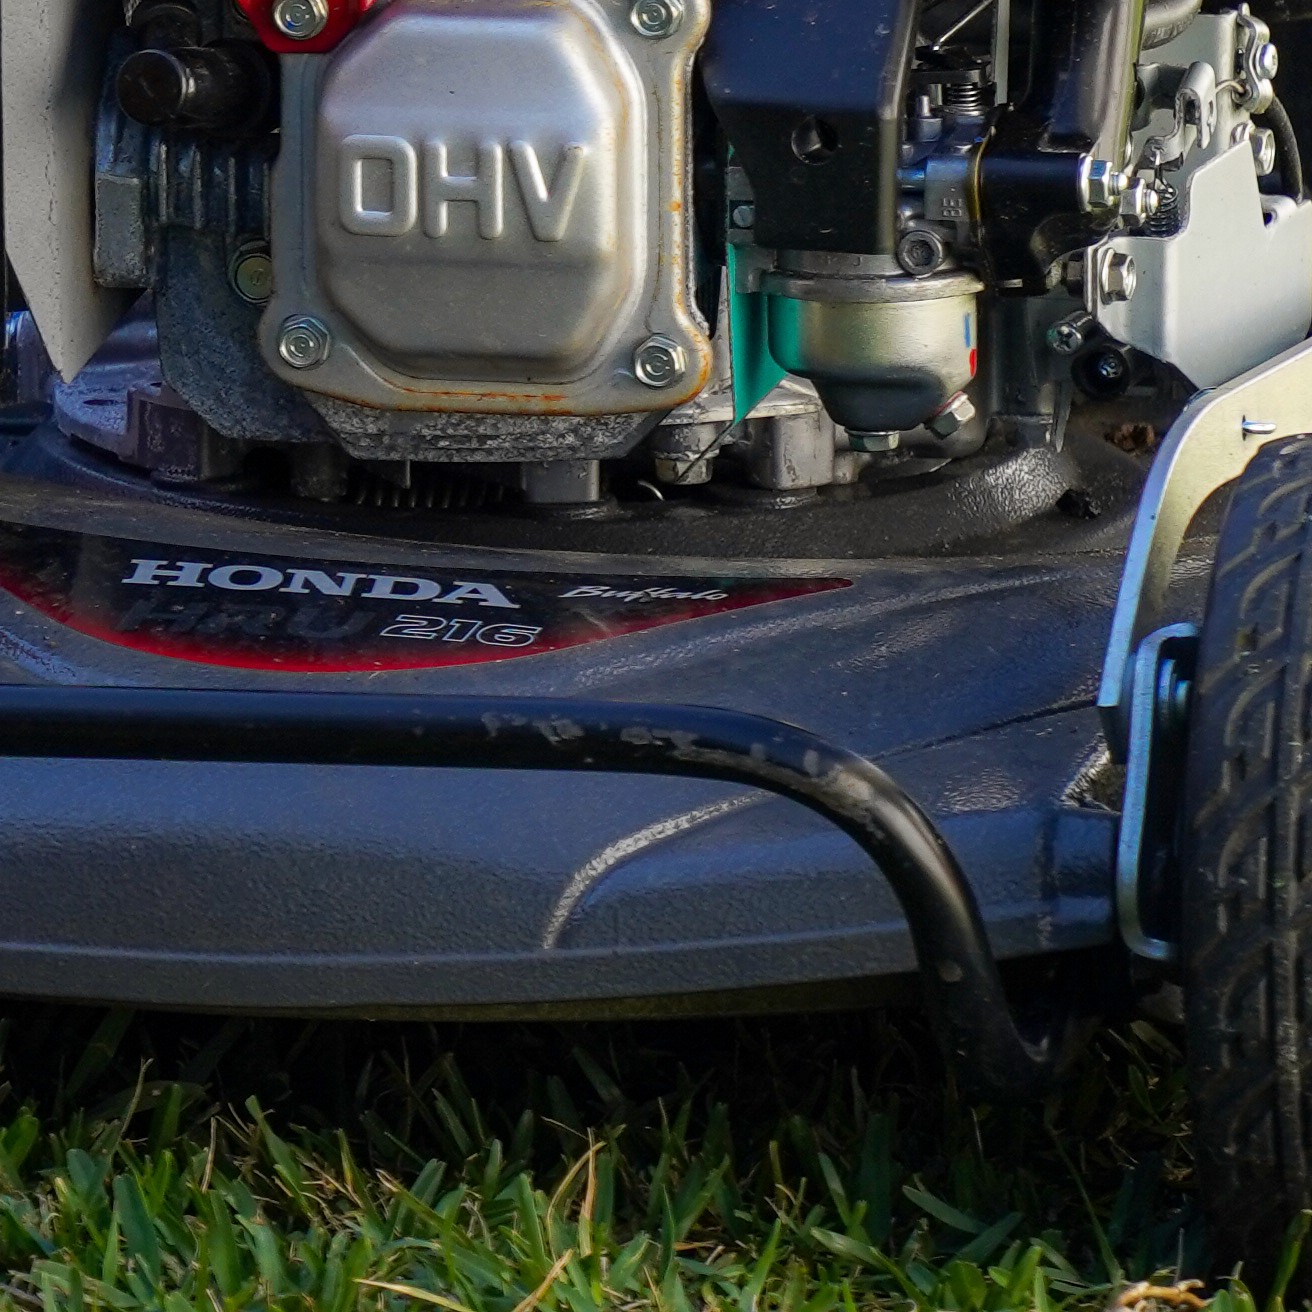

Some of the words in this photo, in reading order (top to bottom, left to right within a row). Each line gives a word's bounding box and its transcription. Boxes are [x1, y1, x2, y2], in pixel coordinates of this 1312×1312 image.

[339, 134, 587, 243] OHV
[121, 559, 522, 610] HONDA
[379, 614, 544, 648] 216
